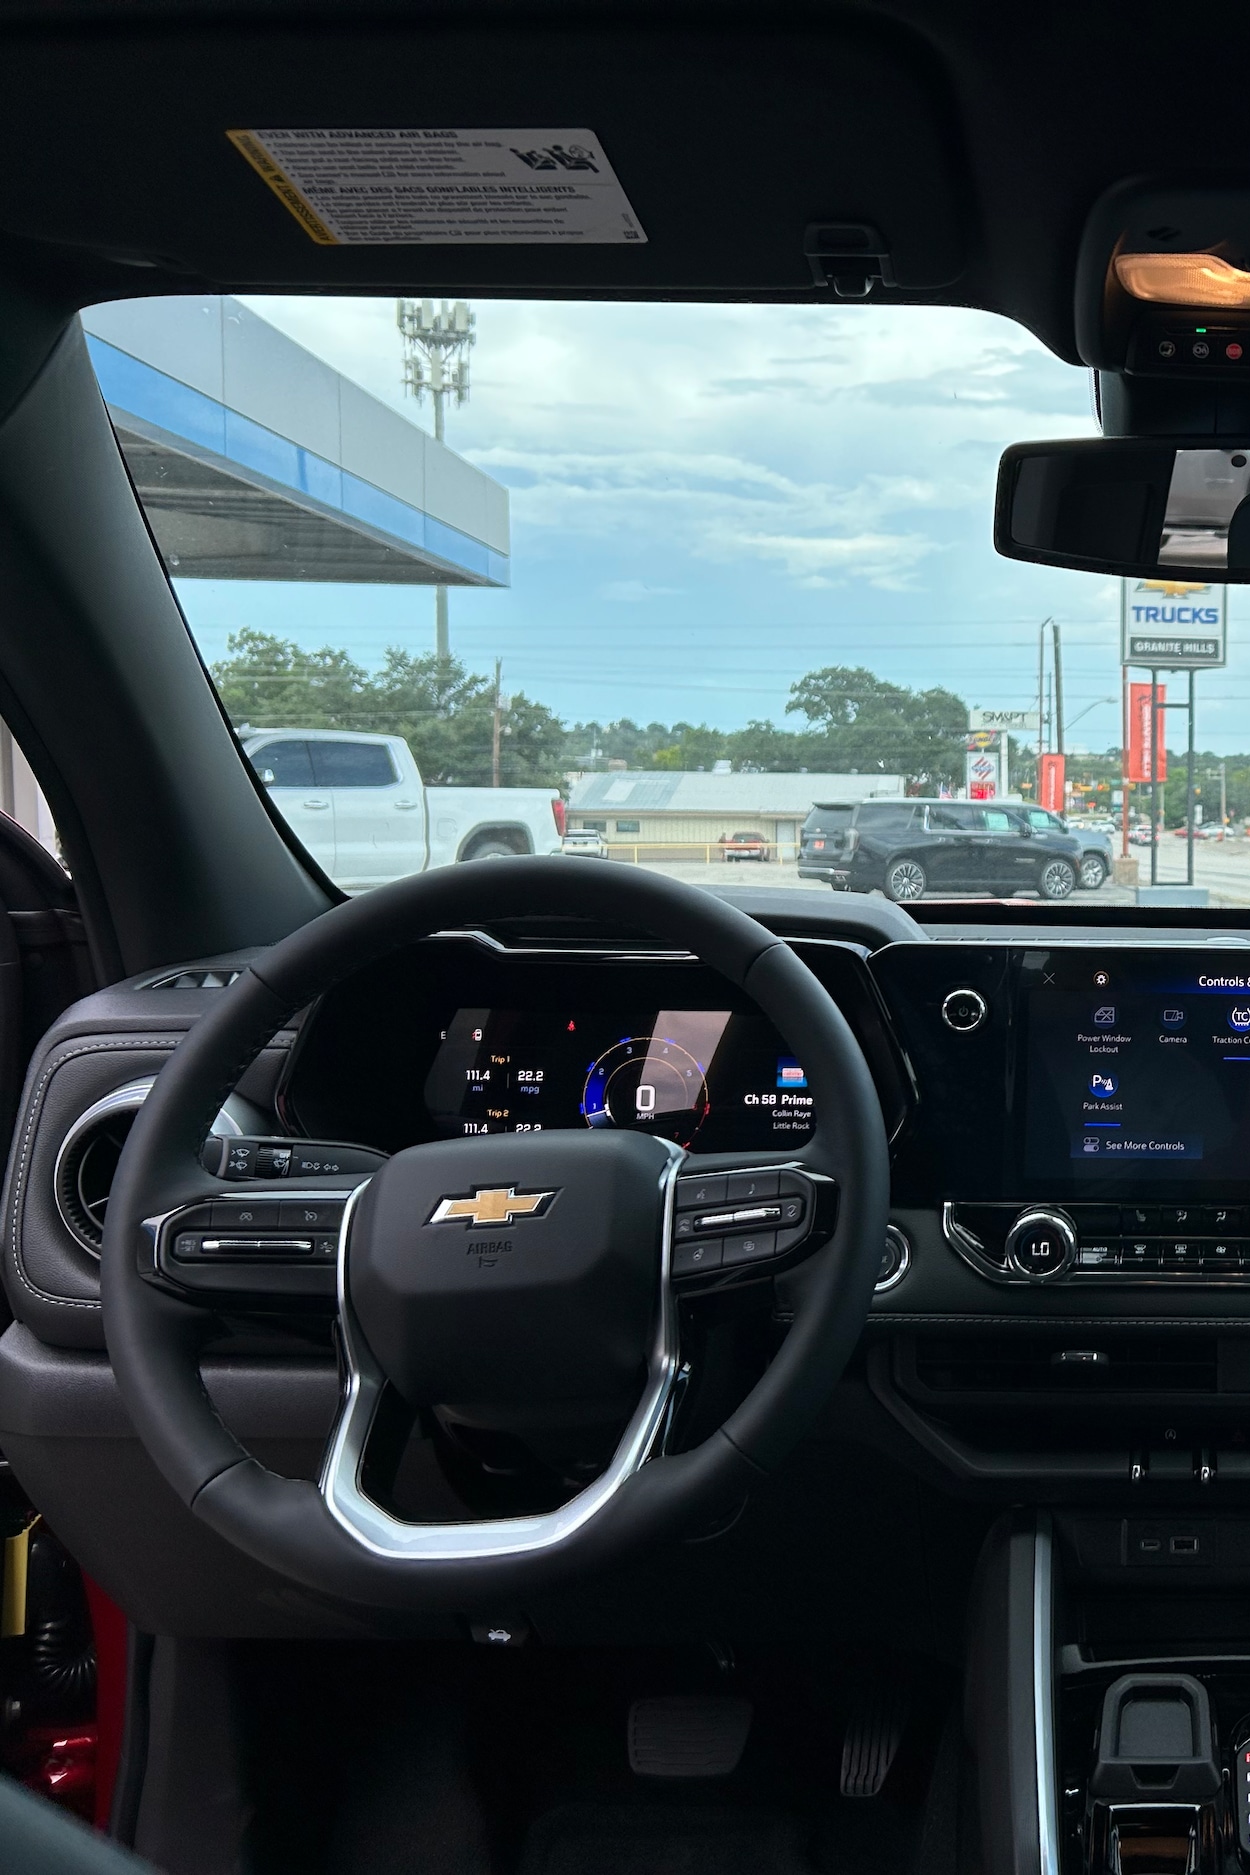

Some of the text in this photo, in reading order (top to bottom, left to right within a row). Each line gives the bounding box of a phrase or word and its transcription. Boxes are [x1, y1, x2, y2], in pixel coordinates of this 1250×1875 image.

[1132, 606, 1219, 625] TRUCKS
[1134, 641, 1182, 653] GRANITE
[1198, 975, 1245, 988] Controls
[440, 1031, 447, 1040] E
[1077, 1034, 1132, 1044] Power Window
[1158, 1035, 1188, 1044] Camera
[1212, 1036, 1242, 1045] Traction
[626, 1047, 633, 1055] 3
[662, 1047, 669, 1055] 4
[1089, 1045, 1119, 1054] Lockout
[490, 1054, 505, 1066] Trip
[466, 1069, 544, 1082] 111.4 22.2
[598, 1068, 605, 1076] 2
[472, 1084, 541, 1095] mi mpg
[635, 1084, 656, 1112] 0
[744, 1093, 814, 1106] Ch 58 Prime
[1083, 1102, 1124, 1111] Park Assist
[487, 1108, 503, 1120] Trip
[636, 1112, 655, 1121] MPH
[772, 1109, 812, 1120] Collin Raye
[464, 1123, 489, 1134] 111.4
[773, 1121, 810, 1131] Little Rock
[1106, 1141, 1185, 1152] See More Controls
[467, 1240, 513, 1256] AIRBAG
